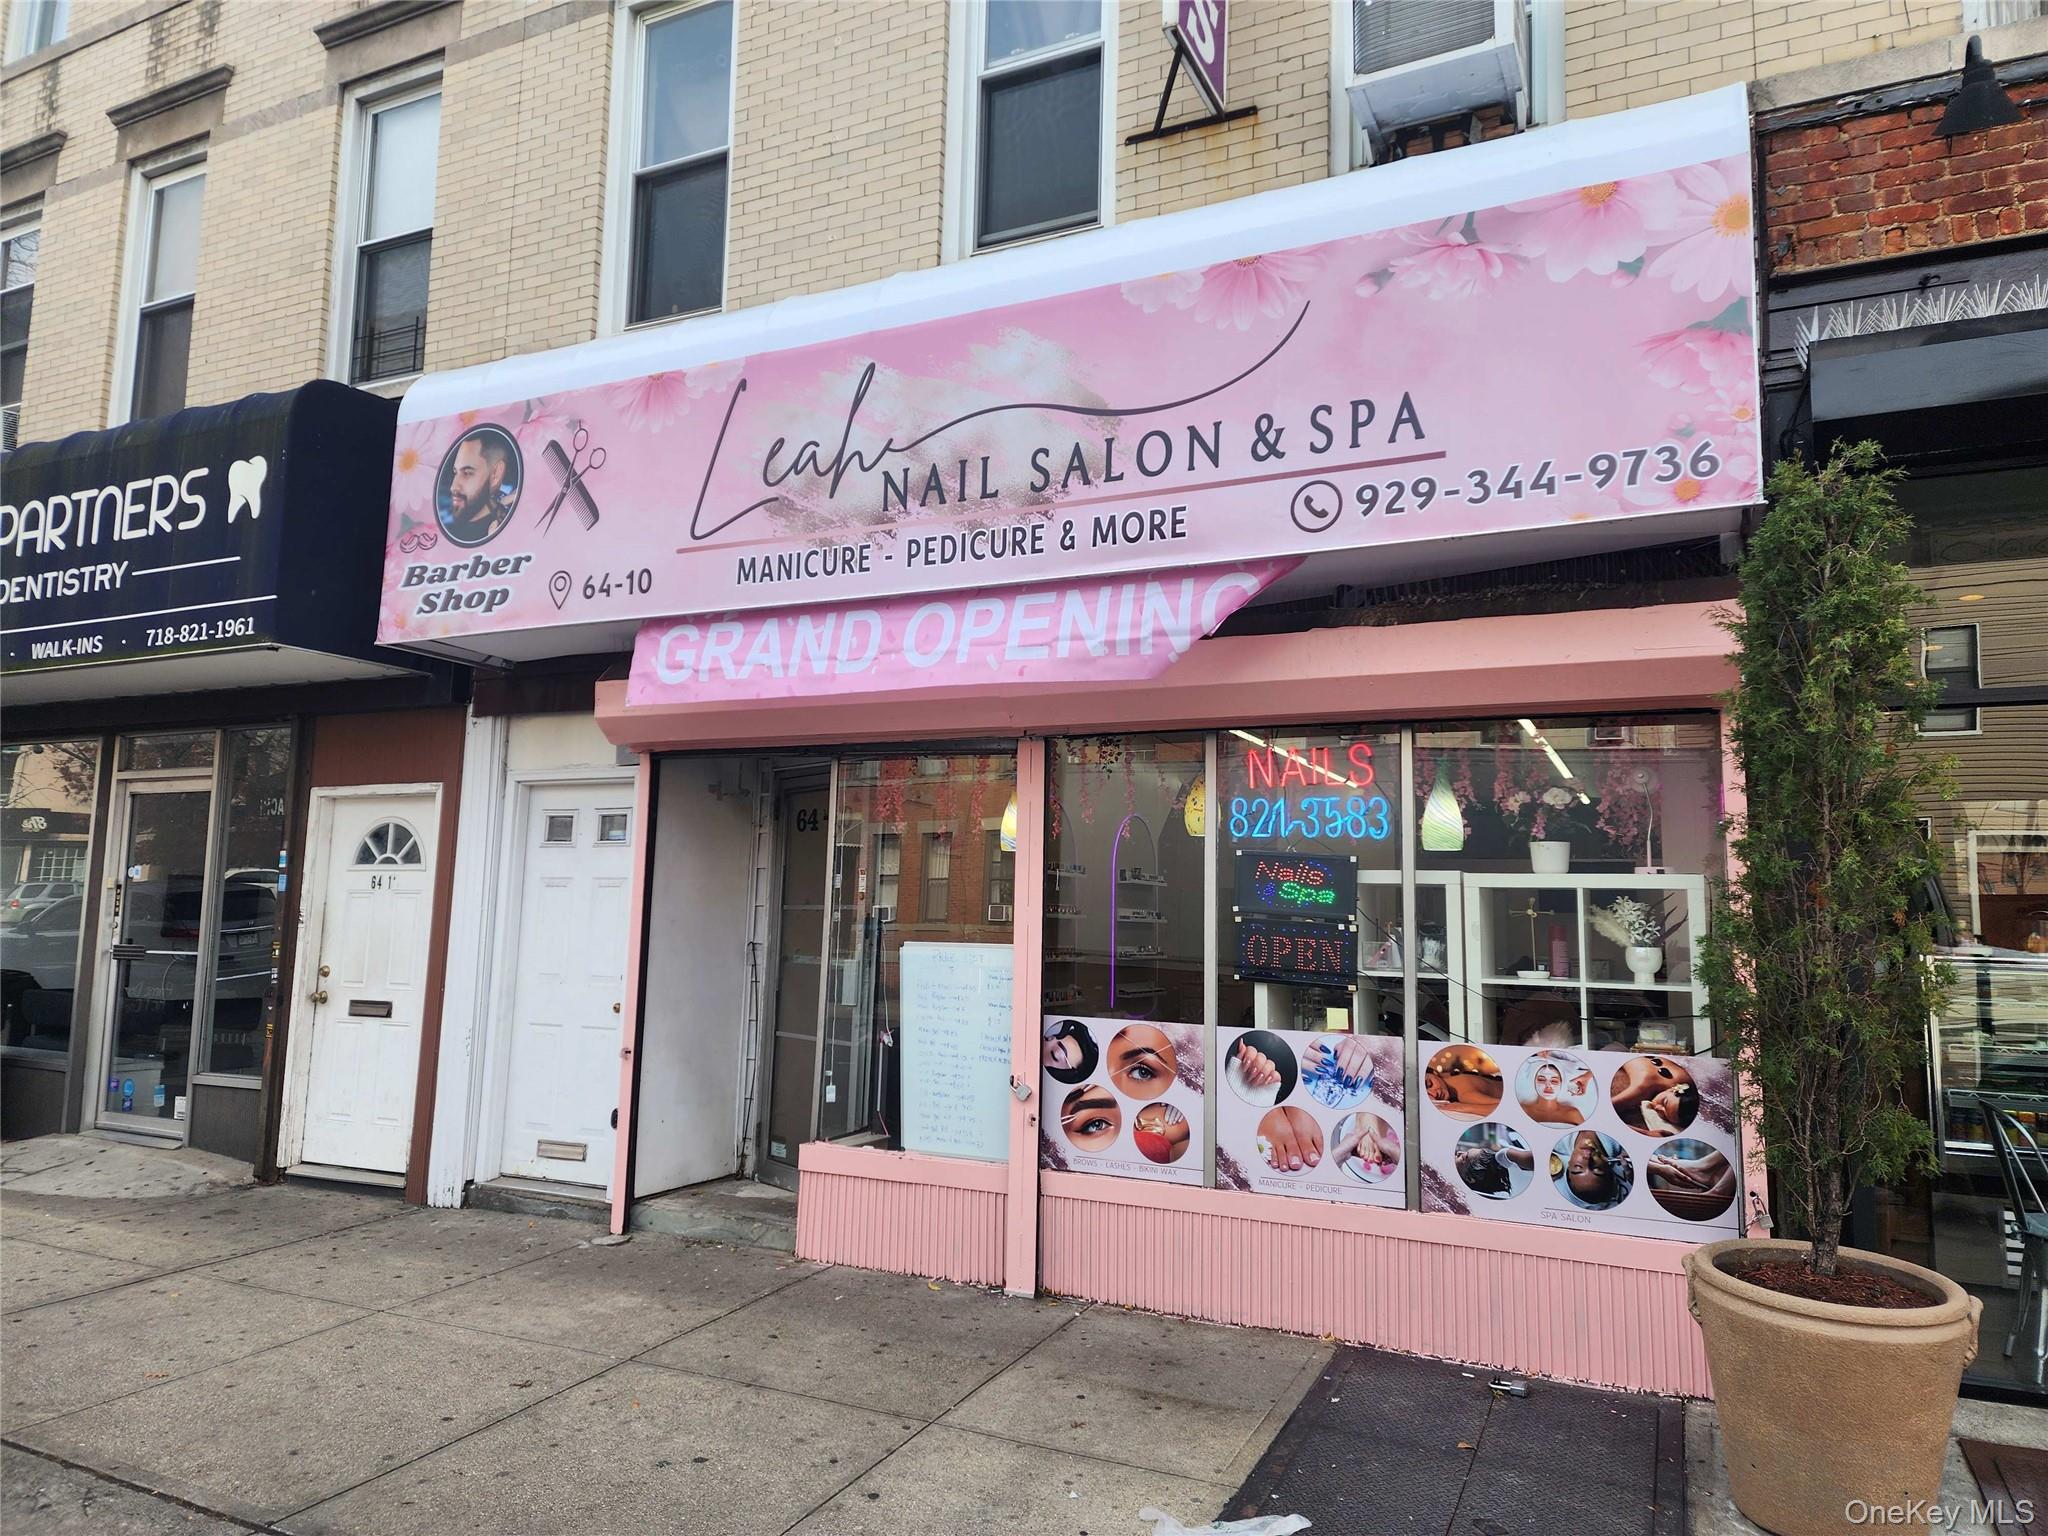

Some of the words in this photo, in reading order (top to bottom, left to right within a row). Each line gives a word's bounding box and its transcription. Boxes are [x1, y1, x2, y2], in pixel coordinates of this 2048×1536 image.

[882, 456, 1000, 513] NAIL
[1030, 421, 1222, 493] SALON
[1250, 412, 1286, 461] &
[1309, 391, 1426, 454] SPA
[1355, 440, 1721, 518] 929-344-9736
[0, 467, 209, 557] PARTNERS
[737, 544, 871, 585] MANICURE
[906, 524, 1045, 568] PEDICURE
[1059, 520, 1075, 551] &
[1092, 506, 1187, 548] MORE
[402, 554, 532, 588] Barber
[582, 568, 652, 599] 64-10
[416, 587, 510, 615] Shop
[31, 636, 103, 660] WALK-INS
[146, 617, 256, 647] 718-821-1961
[655, 608, 882, 686] GRAND
[1248, 743, 1375, 789] NAILS
[1255, 861, 1325, 886] Nails
[1279, 881, 1336, 905] Spa
[1247, 935, 1344, 973] OPEN
[1073, 1158, 1098, 1168] BROWS
[1138, 1165, 1159, 1175] BIKINI
[1160, 1168, 1177, 1177] WAX
[1258, 1179, 1296, 1190] MANICURE
[1305, 1183, 1343, 1195] PEDICURE
[1540, 1211, 1558, 1220] SPA
[1560, 1213, 1592, 1224] SALON
